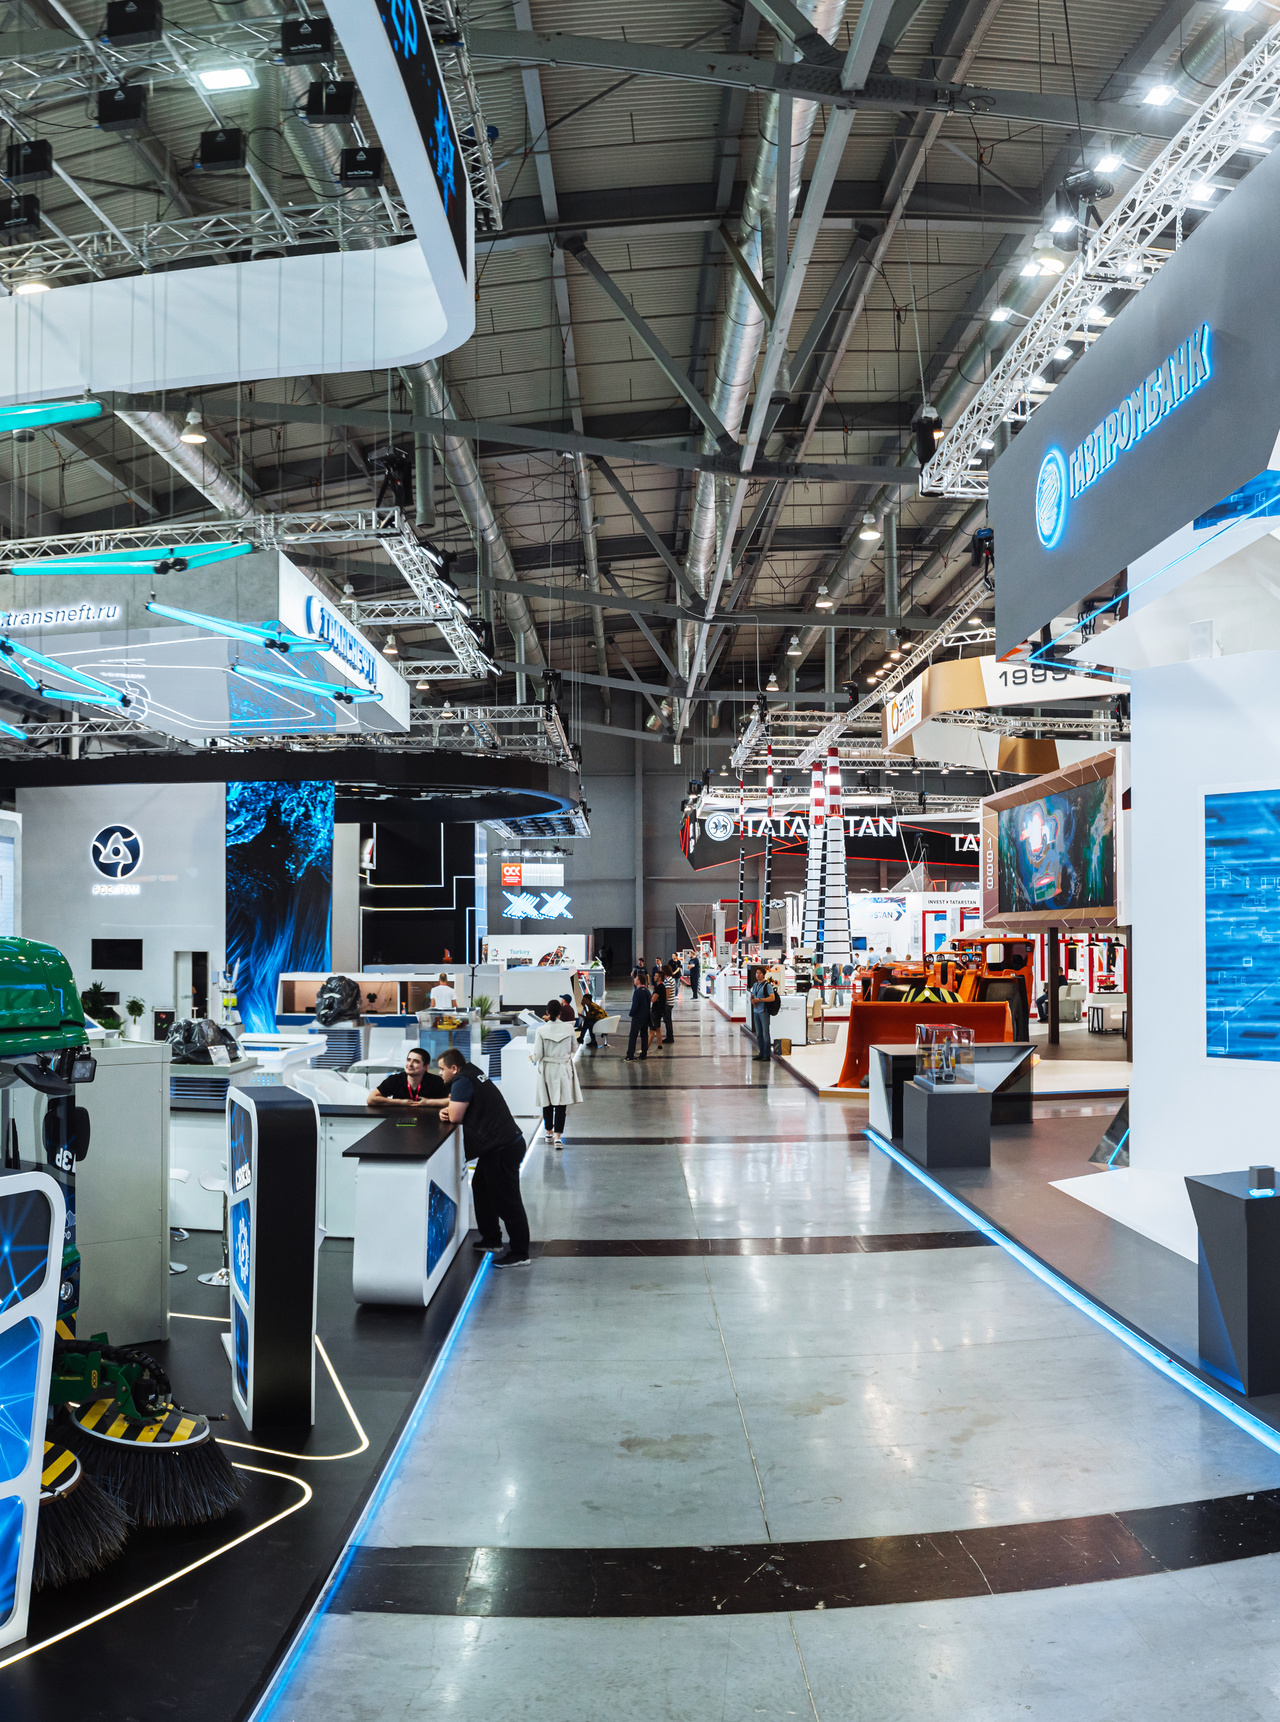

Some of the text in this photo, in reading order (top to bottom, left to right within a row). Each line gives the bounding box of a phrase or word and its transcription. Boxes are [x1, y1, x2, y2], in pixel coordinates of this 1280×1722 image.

[1069, 323, 1209, 499] ГАЗПРОМБАНК
[742, 815, 897, 837] TATATAN
[986, 837, 994, 890] 1999
